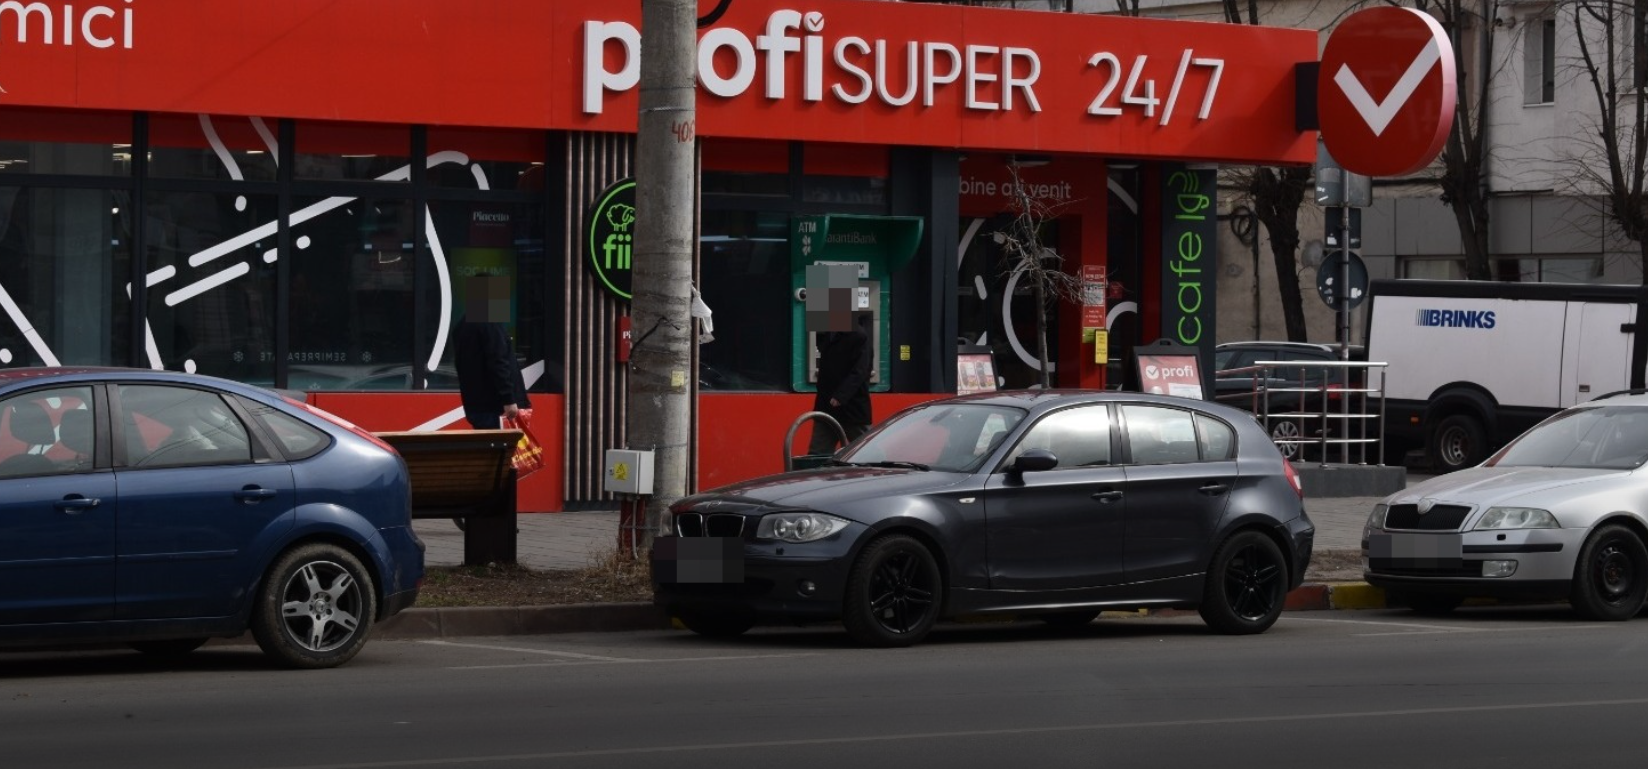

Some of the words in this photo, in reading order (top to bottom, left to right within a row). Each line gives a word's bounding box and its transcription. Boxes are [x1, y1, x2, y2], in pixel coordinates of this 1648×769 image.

[583, 9, 824, 113] pofi
[832, 36, 1042, 112] SUPER
[1088, 49, 1224, 125] 24/7
[959, 176, 997, 196] bine
[1029, 181, 1071, 199] venit
[798, 221, 817, 233] ATM
[1169, 231, 1202, 344] cafe
[1427, 309, 1496, 329] BRINKS
[1161, 365, 1194, 380] profi
